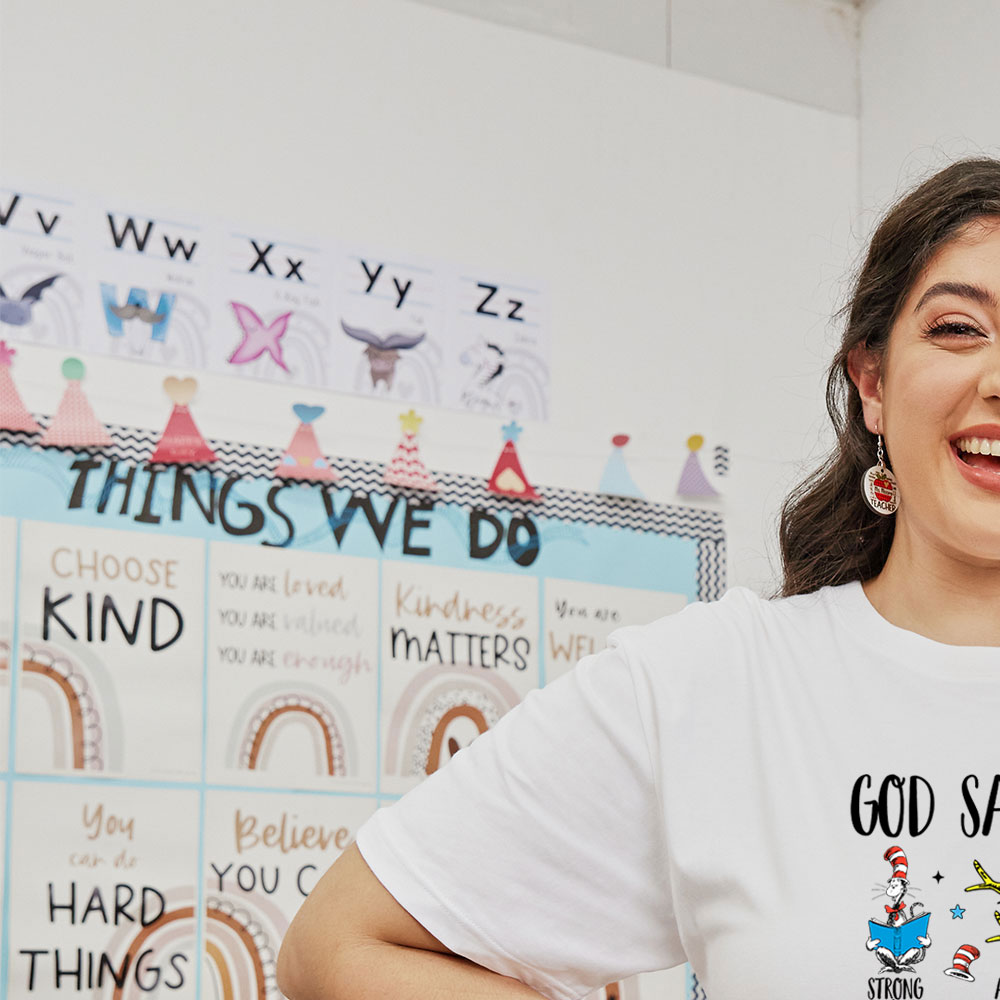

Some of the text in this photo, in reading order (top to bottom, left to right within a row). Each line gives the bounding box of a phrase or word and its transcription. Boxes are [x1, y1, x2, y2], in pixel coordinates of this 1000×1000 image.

[107, 213, 197, 262] W w
[249, 240, 304, 282] X x
[361, 260, 412, 309] Y y
[476, 282, 524, 322] Z z
[68, 459, 541, 567] THINGS WE DO
[51, 548, 180, 590] CHOOSE
[42, 587, 183, 651] KIND
[395, 580, 528, 630] Kindness
[82, 804, 136, 841] You
[851, 774, 935, 838] GOD
[209, 861, 281, 895] YOU
[44, 880, 168, 930] HARD
[16, 946, 190, 993] THINGS
[868, 977, 923, 1000] STRONG
